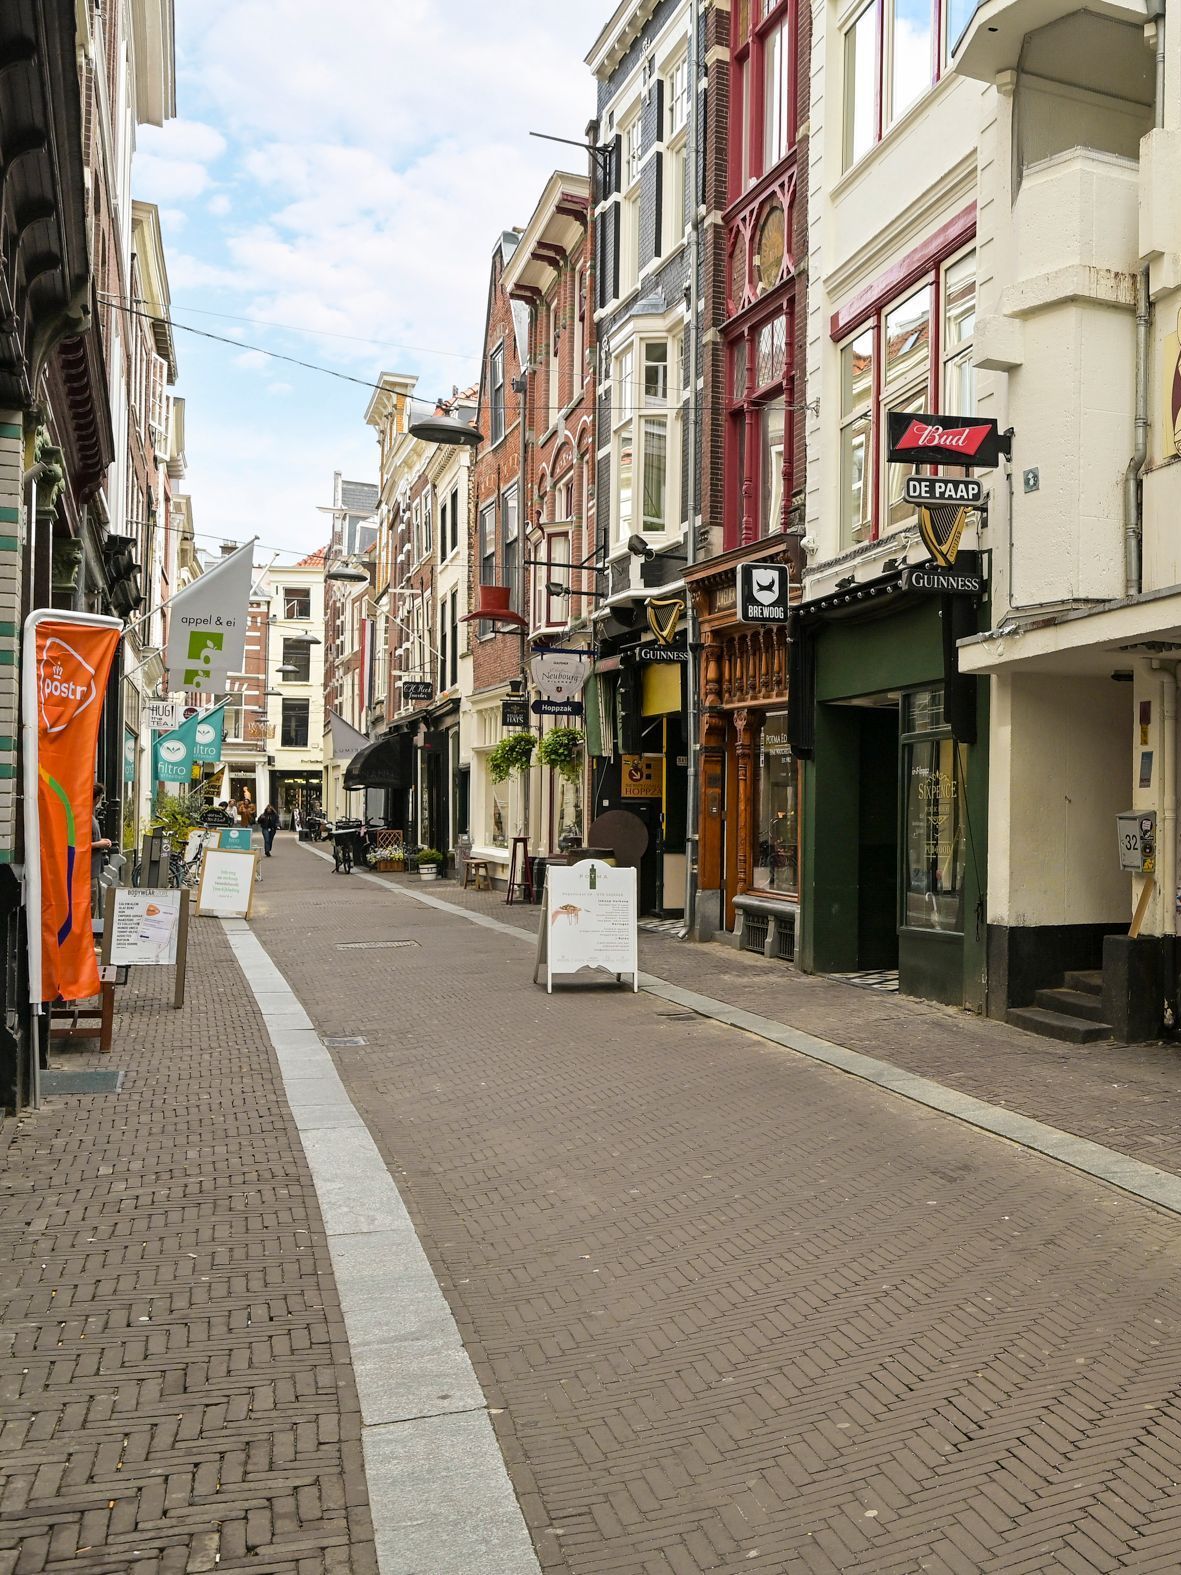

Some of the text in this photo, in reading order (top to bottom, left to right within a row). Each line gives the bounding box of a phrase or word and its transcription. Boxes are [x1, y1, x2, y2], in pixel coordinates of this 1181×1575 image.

[913, 425, 970, 447] Bud
[909, 480, 979, 499] DE PAAP
[911, 572, 979, 590] GUINNESS
[748, 606, 784, 619] BREWDOG
[181, 614, 236, 627] appel & ei
[641, 649, 689, 661] GUINNESS
[541, 704, 573, 712] Hoppzak
[158, 761, 187, 775] filtro
[918, 780, 958, 800] SIXPENCE
[1125, 834, 1139, 851] 32
